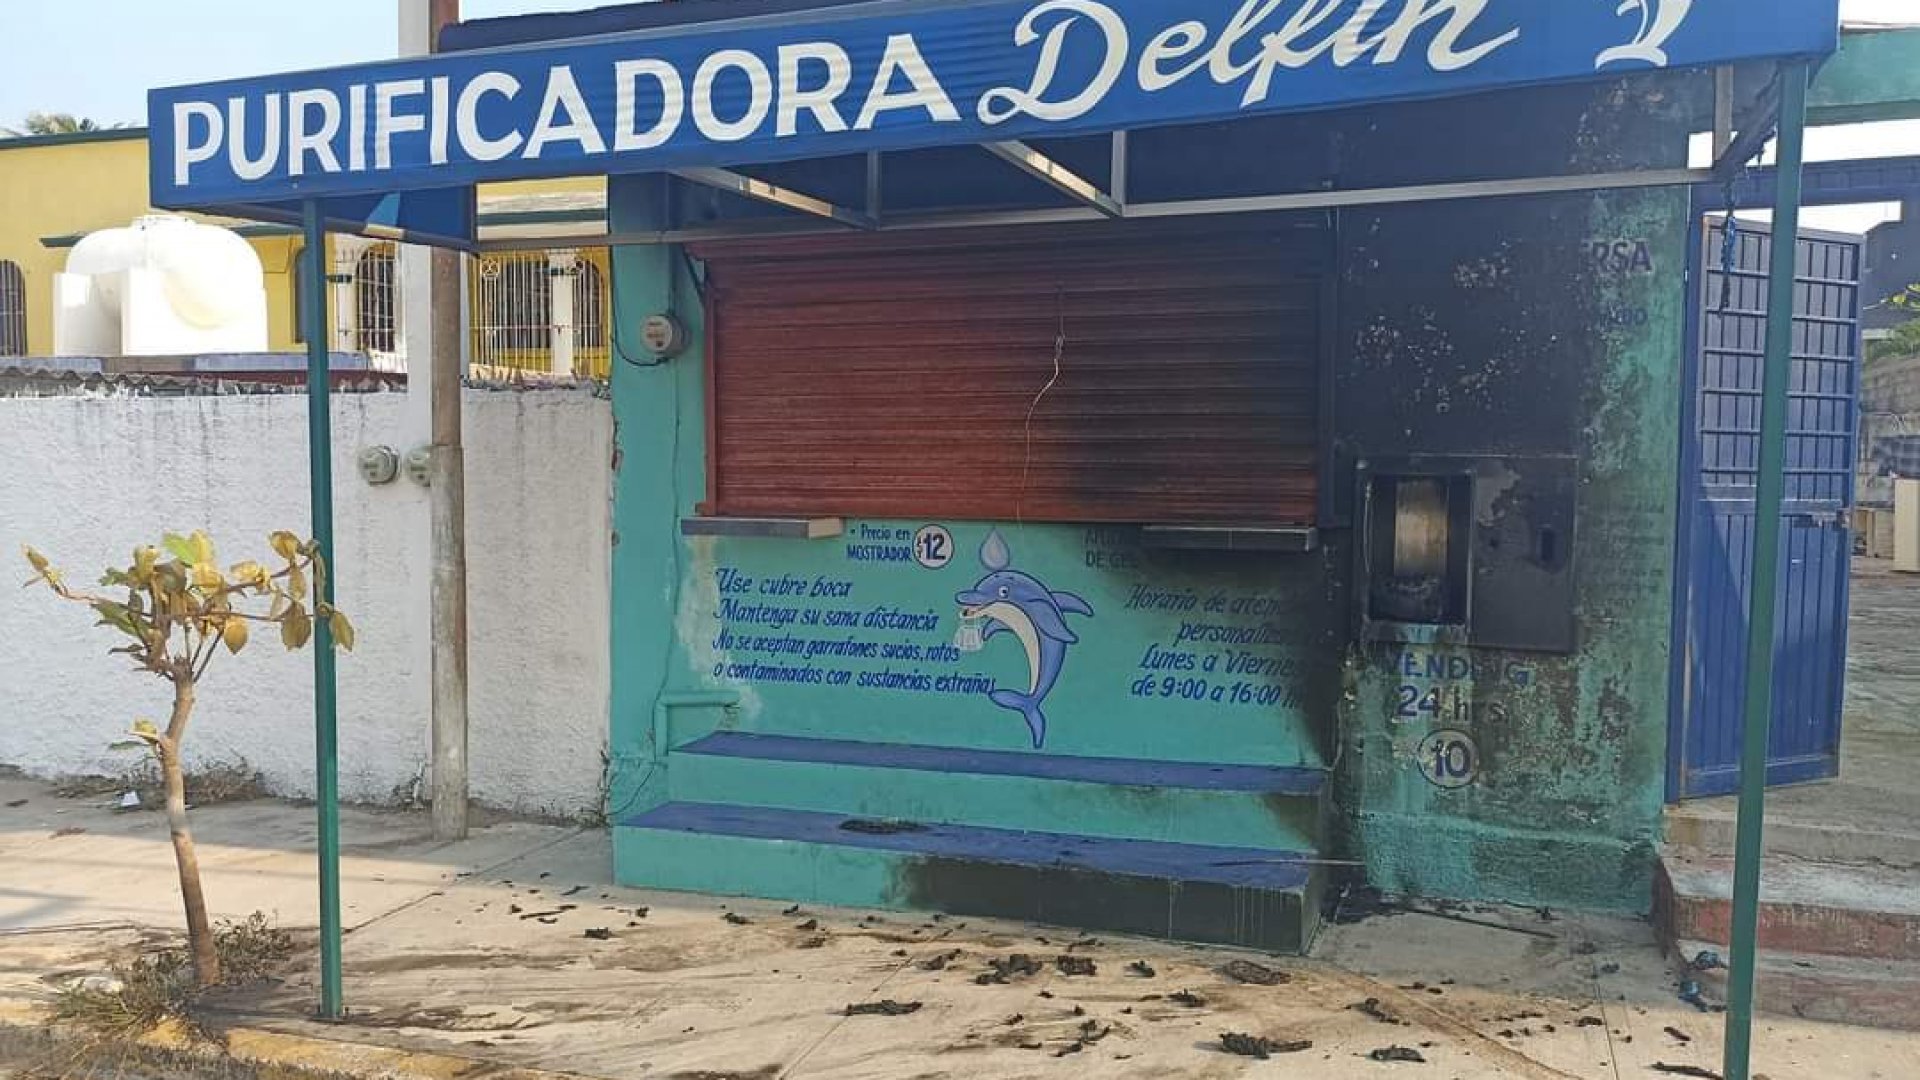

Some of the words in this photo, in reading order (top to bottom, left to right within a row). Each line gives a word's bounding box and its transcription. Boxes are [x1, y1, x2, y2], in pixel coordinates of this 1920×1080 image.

[173, 33, 962, 186] PURIFICADORA
[860, 523, 891, 540] Precio
[895, 529, 910, 540] en
[847, 545, 912, 560] MOSTRADOR
[715, 567, 753, 593] Use
[759, 574, 808, 595] cubre
[809, 576, 853, 598] boca
[1123, 584, 1196, 611] Horario
[1204, 587, 1225, 613] de
[713, 598, 798, 629] Mantenga
[800, 608, 821, 625] su
[824, 610, 861, 627] sana
[863, 606, 939, 631] distancia
[712, 628, 733, 650] No
[735, 636, 752, 650] se
[753, 632, 804, 657] aceptan
[802, 635, 878, 660] garrafones
[1140, 643, 1195, 670] Lunes
[1203, 655, 1218, 671] a
[713, 662, 724, 677] o
[726, 659, 824, 684] contaminados
[826, 669, 852, 685] con
[856, 667, 932, 691] sustancias
[1132, 674, 1156, 697] de
[1159, 676, 1207, 700] 9:00
[1210, 685, 1225, 702] a
[1229, 681, 1281, 705] 16:00
[1396, 685, 1440, 718] 24
[1431, 740, 1471, 777] 10
